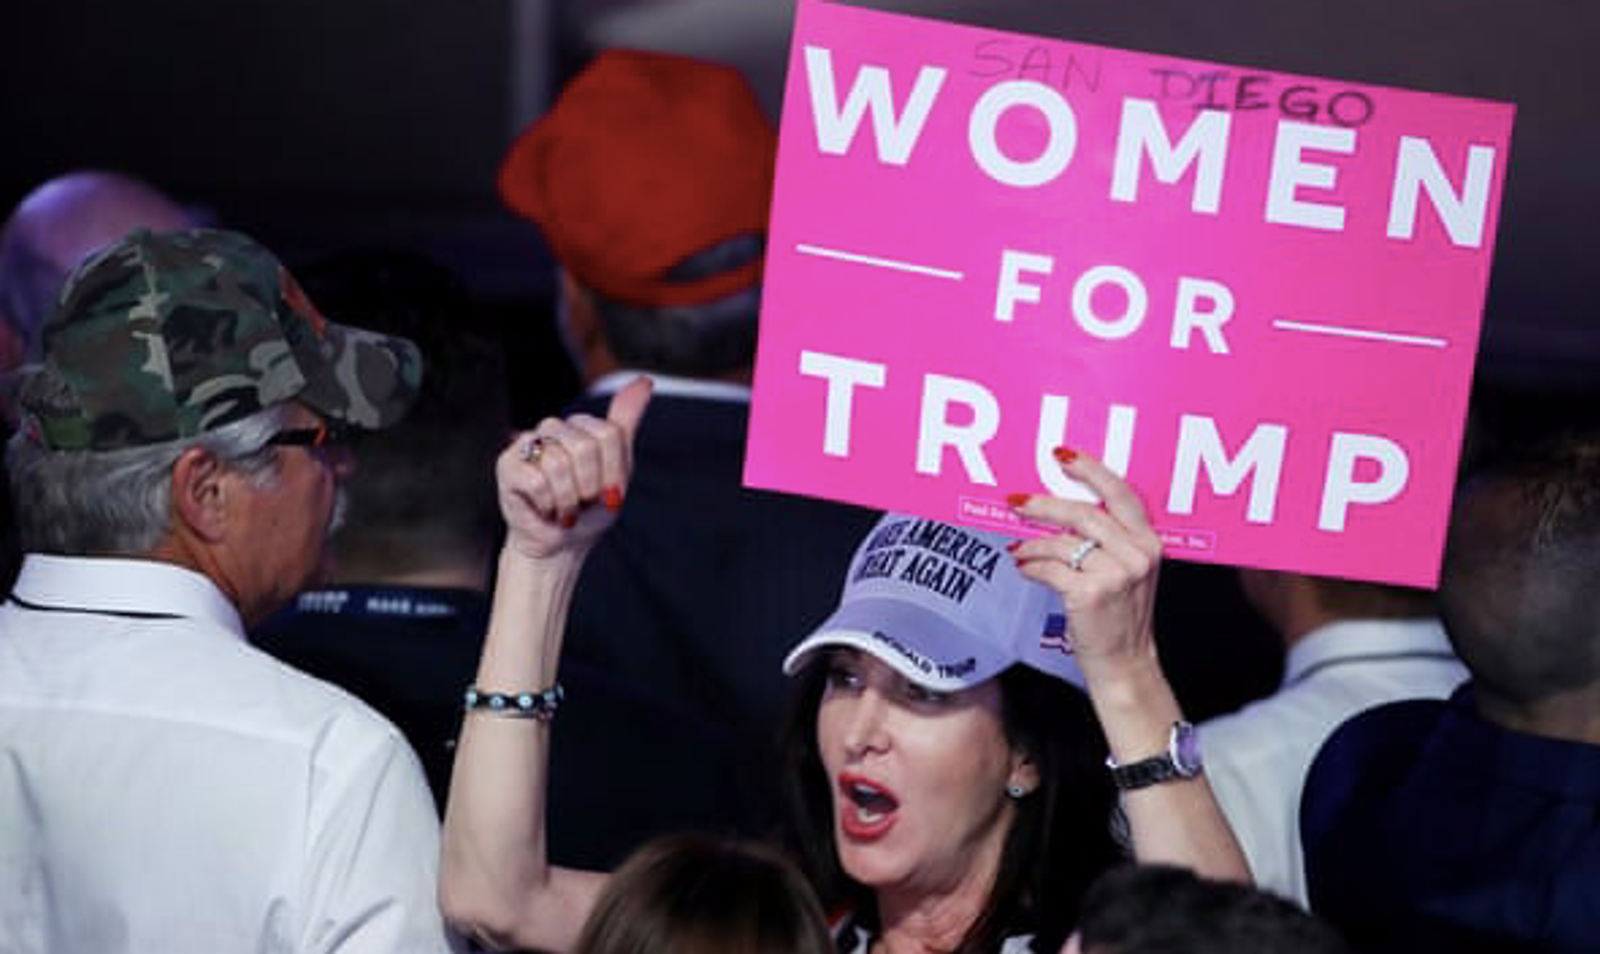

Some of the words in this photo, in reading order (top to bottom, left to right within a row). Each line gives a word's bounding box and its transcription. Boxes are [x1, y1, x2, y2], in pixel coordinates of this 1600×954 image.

[970, 38, 1101, 93] SAN
[1150, 67, 1376, 128] DIEGO
[803, 45, 1496, 248] WOMEN
[994, 249, 1236, 354] FOR
[798, 350, 1410, 532] TRUMP
[899, 550, 976, 604] AGAIN
[902, 517, 1001, 582] AMERICA
